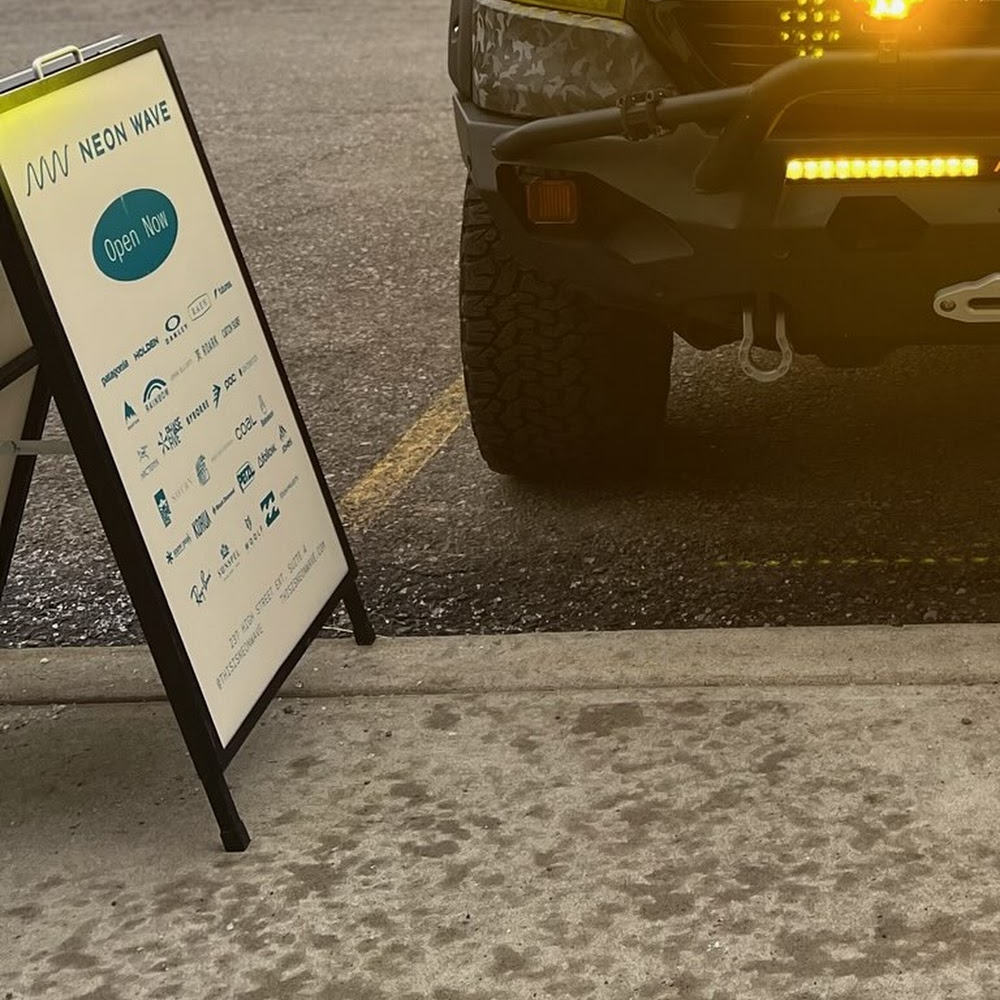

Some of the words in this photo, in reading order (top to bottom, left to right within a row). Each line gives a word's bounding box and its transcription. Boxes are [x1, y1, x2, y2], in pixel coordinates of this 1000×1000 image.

[78, 121, 128, 163] NEON
[129, 100, 171, 136] WAVE
[104, 229, 140, 262] Open
[141, 211, 168, 238] Now
[133, 336, 159, 361] HOLDEN
[255, 586, 273, 615] STREET
